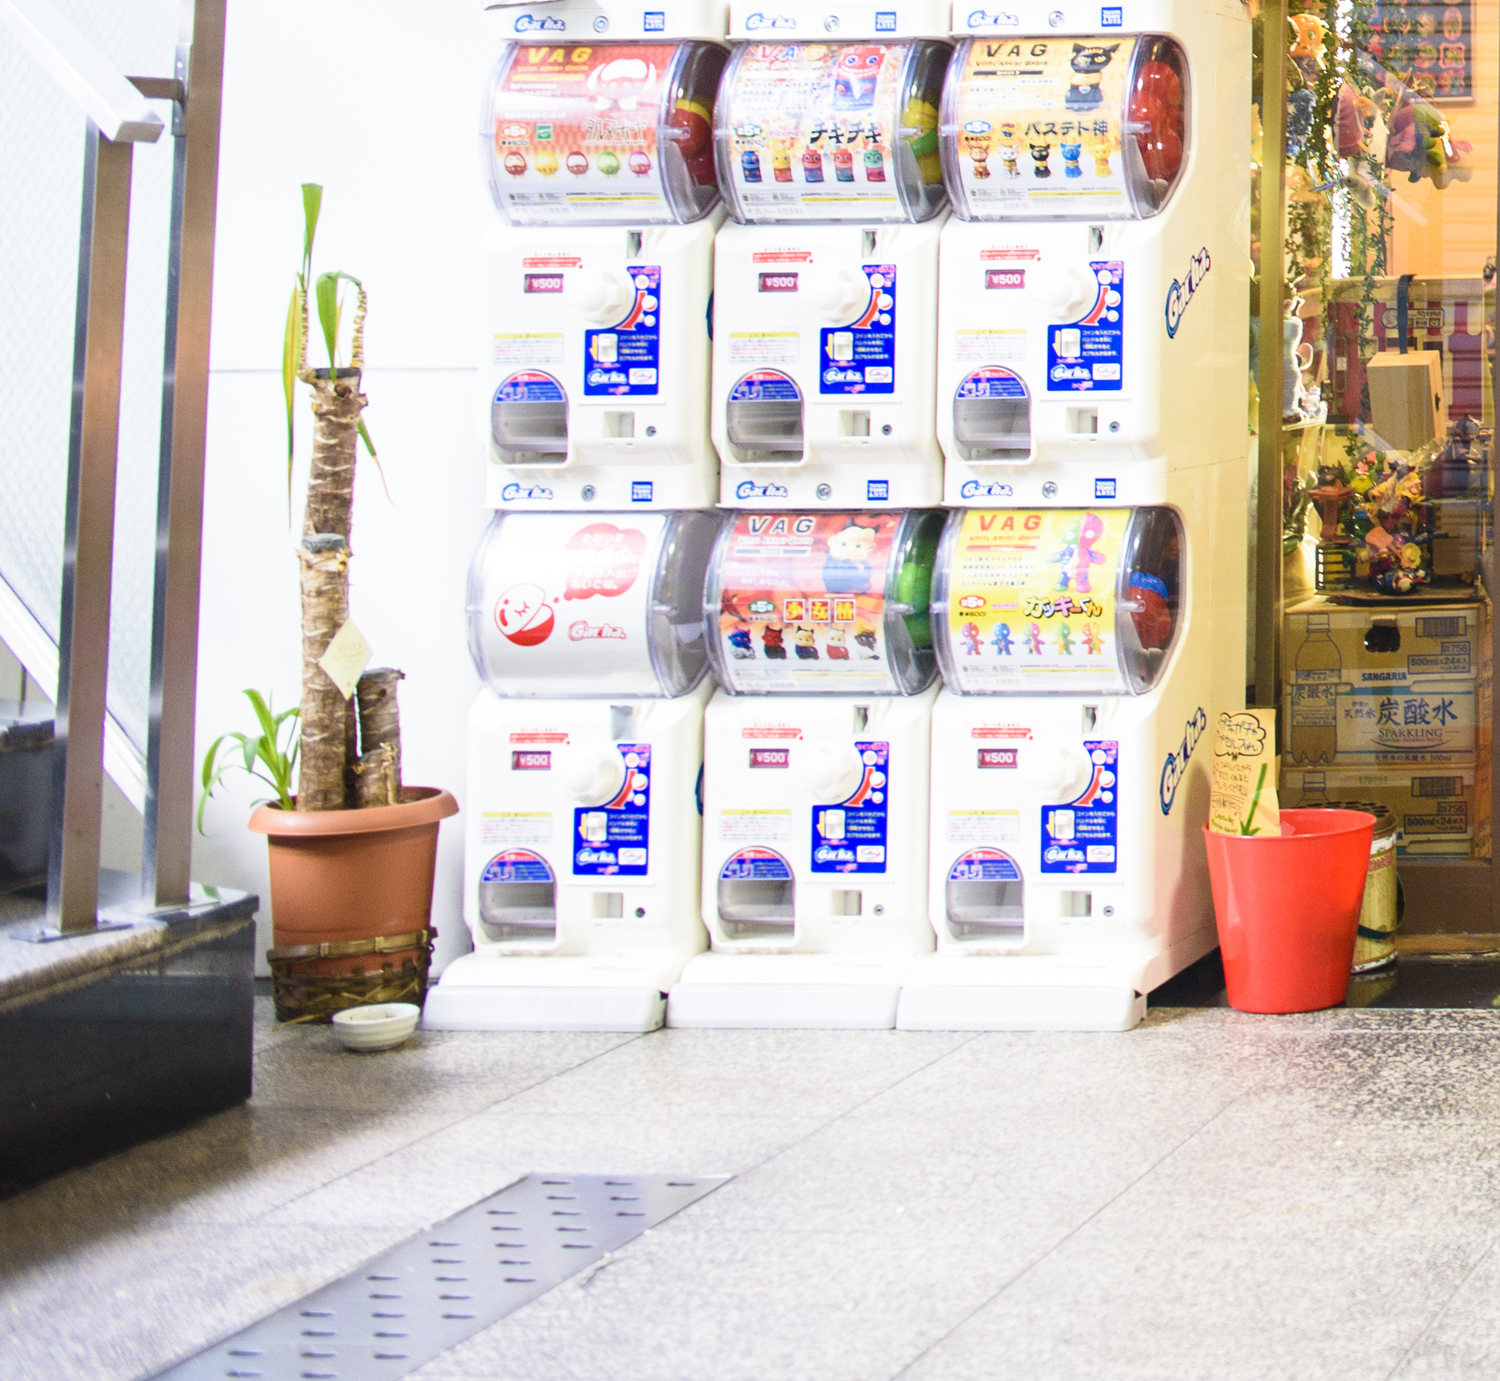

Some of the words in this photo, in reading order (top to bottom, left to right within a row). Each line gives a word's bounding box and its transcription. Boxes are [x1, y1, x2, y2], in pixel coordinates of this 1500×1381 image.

[528, 47, 593, 63] VAG
[760, 46, 823, 59] VAG
[986, 44, 1048, 57] VAG
[810, 121, 882, 144] チキチキ
[1024, 120, 1108, 137] バステト神
[532, 278, 561, 289] ¥500
[765, 277, 794, 287] ¥500
[991, 274, 1021, 284] ¥500
[750, 517, 815, 534] VAG
[979, 514, 1042, 531] VAG
[787, 601, 854, 620] 少女椿
[1023, 595, 1102, 618] ガッキーくん
[1361, 672, 1407, 681] SANGARIA
[1376, 697, 1459, 726] 炭酸水
[1378, 728, 1443, 738] SPARKLING
[519, 755, 548, 766] ¥500
[756, 752, 786, 763] ¥500
[984, 752, 1013, 763] ¥500
